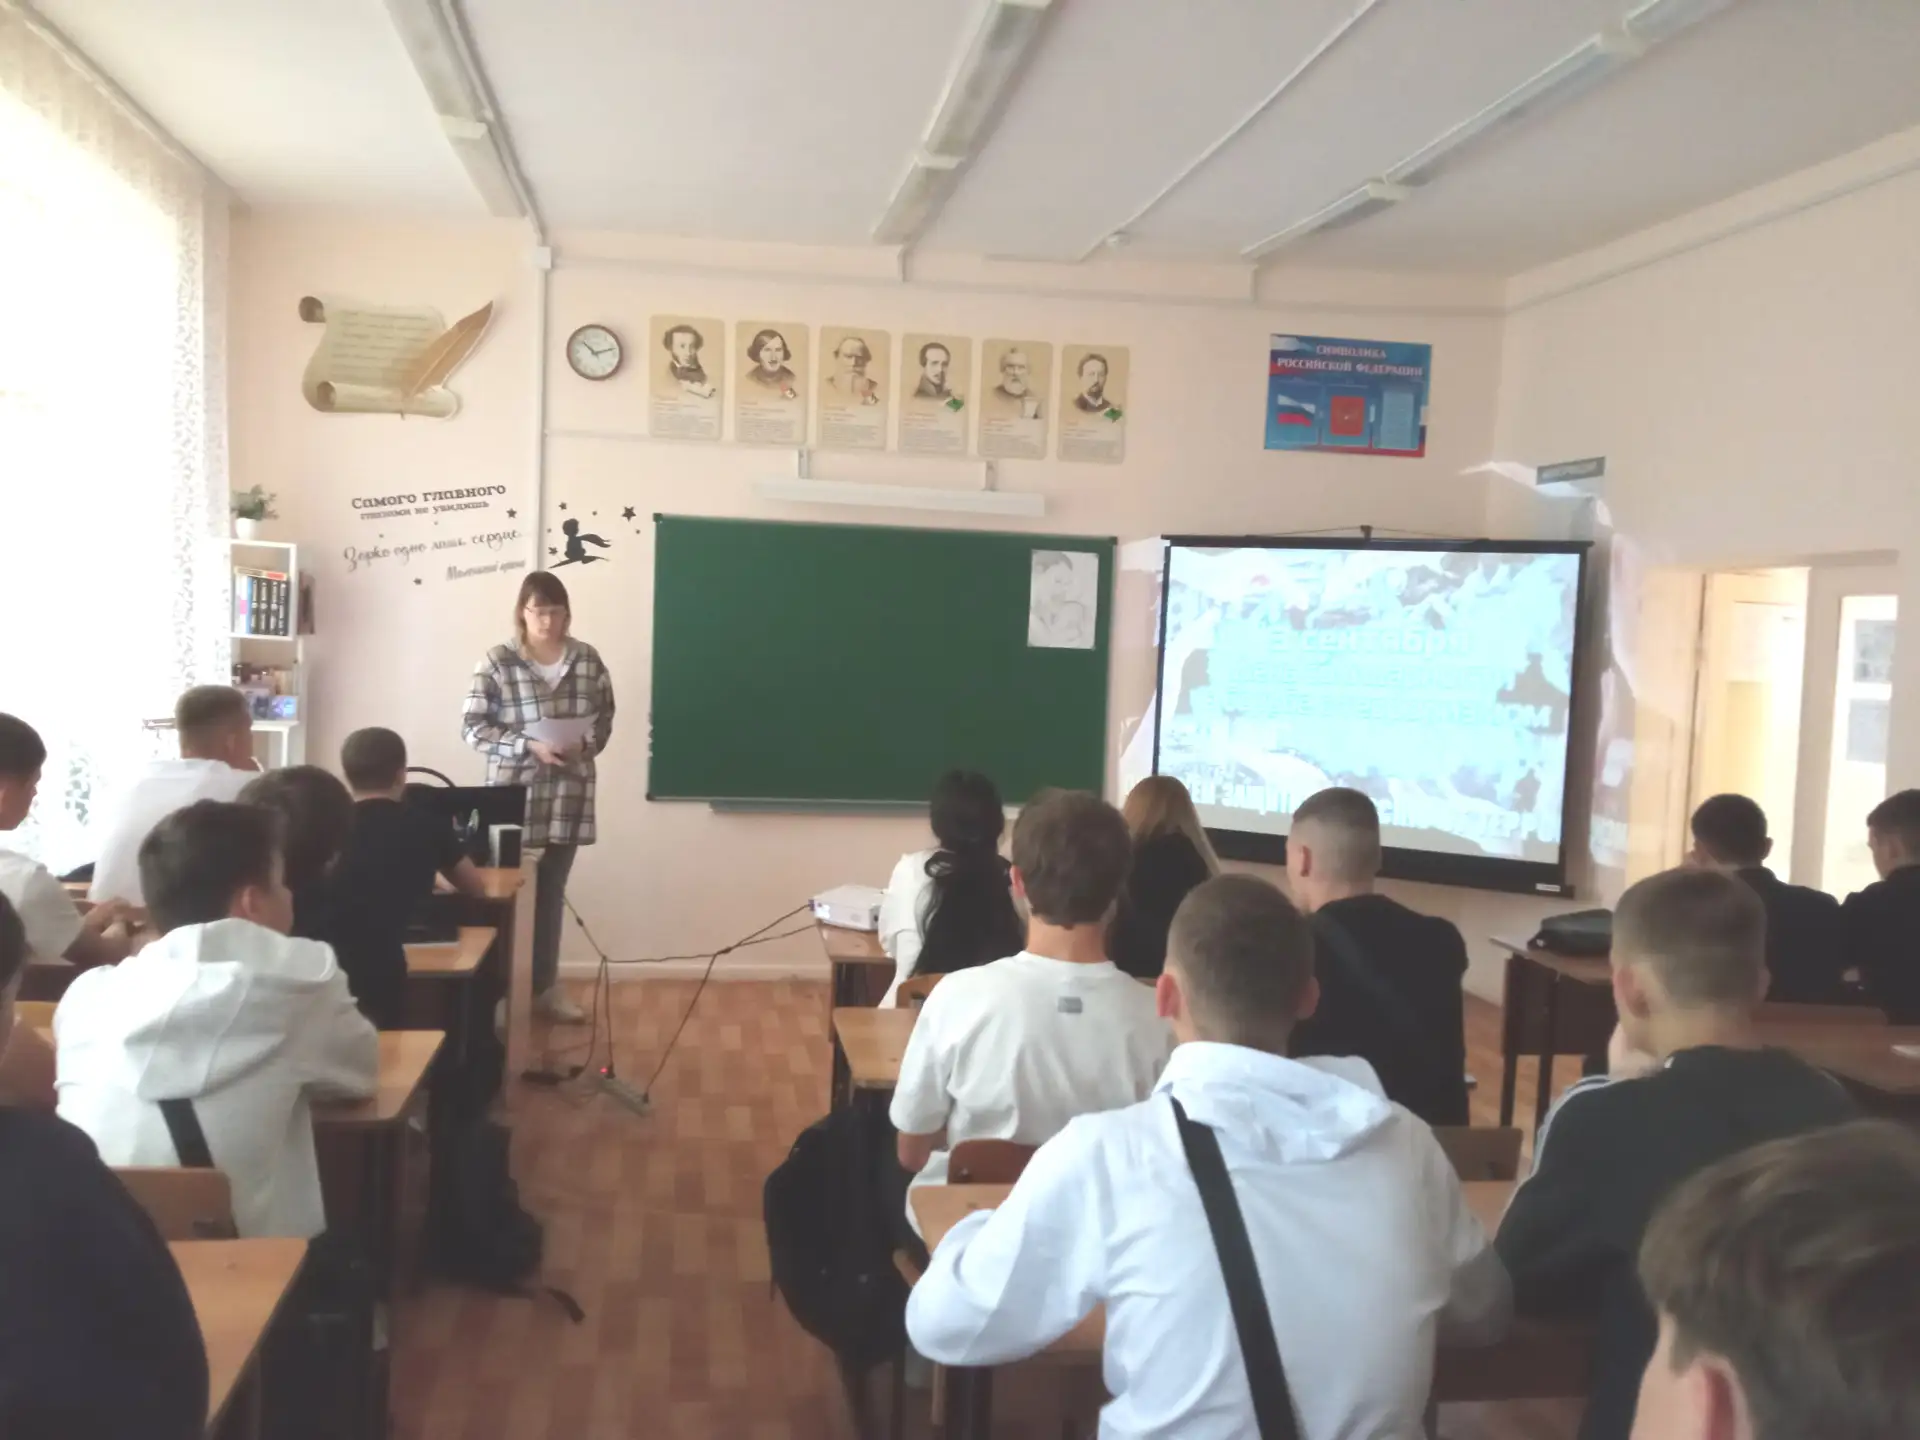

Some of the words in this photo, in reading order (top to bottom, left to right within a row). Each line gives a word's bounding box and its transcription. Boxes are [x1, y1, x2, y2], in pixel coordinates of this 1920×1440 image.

[1277, 357, 1352, 372] РОССИЙСКОЙ
[1355, 362, 1424, 377] ФЕДЕРАЦИИ
[351, 493, 417, 509] Самого
[422, 484, 507, 502] главного
